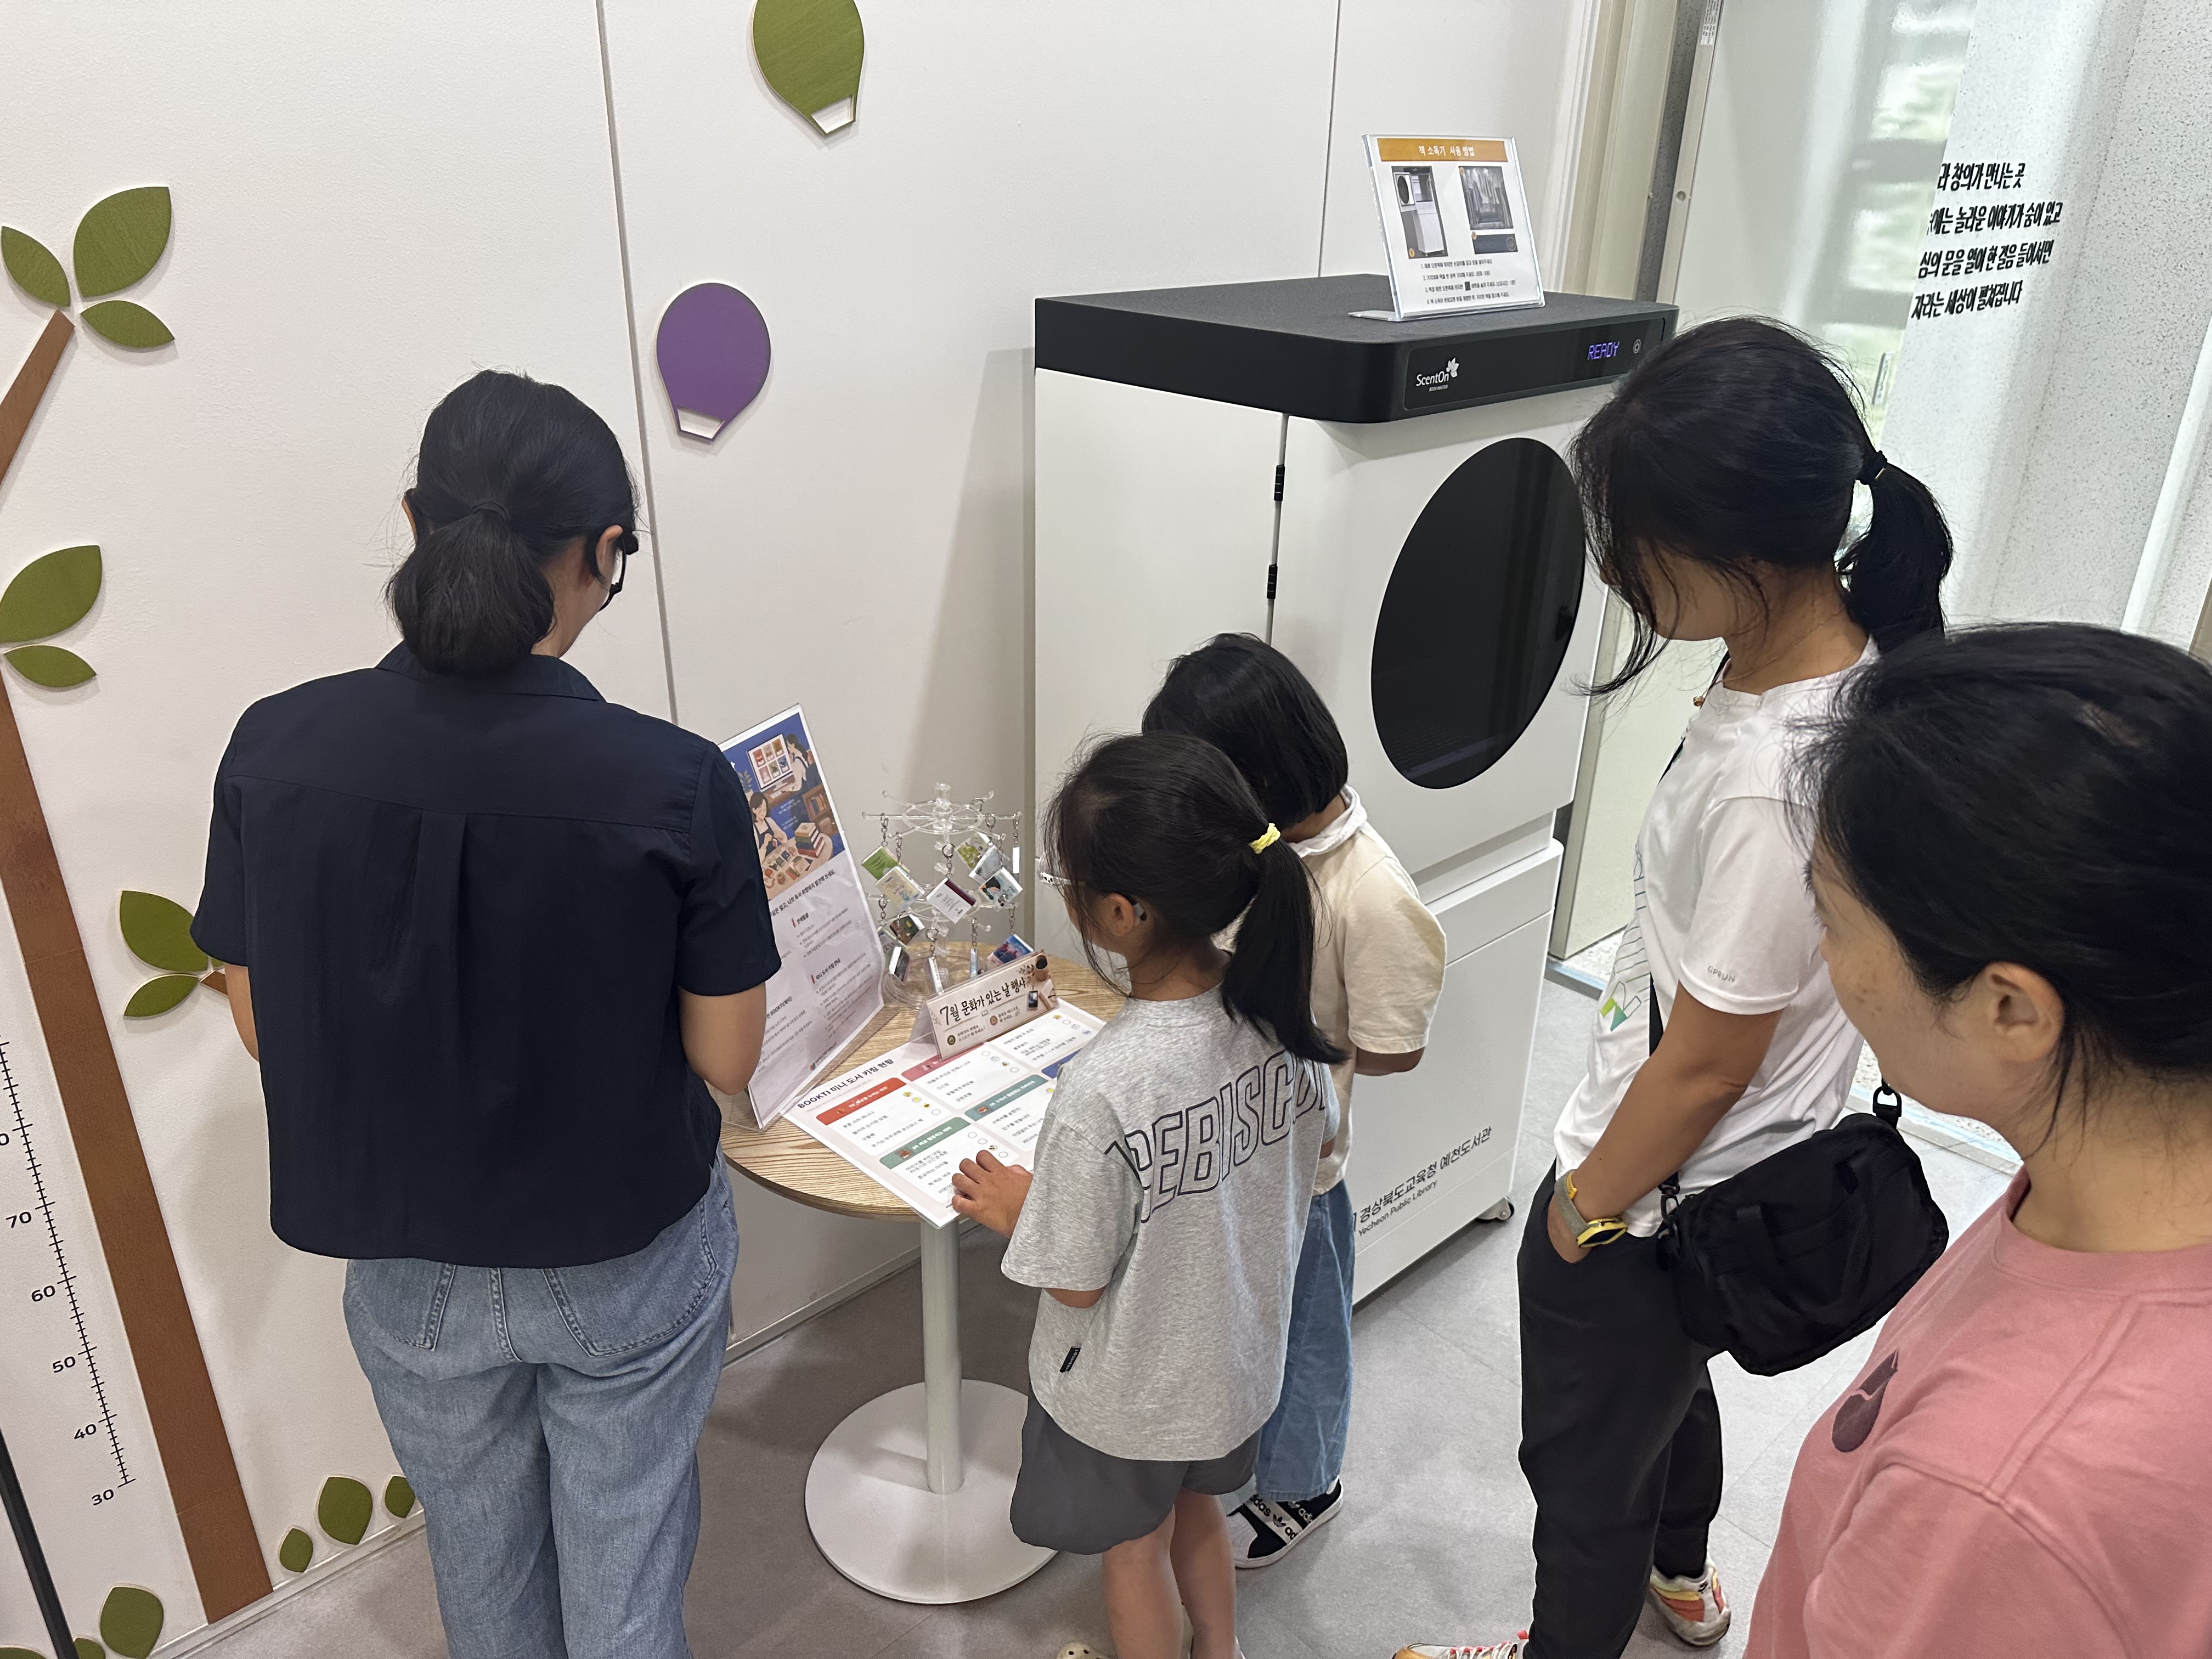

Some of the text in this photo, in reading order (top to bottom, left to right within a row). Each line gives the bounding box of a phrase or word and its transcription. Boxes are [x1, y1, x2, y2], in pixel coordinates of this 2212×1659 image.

[1419, 146, 1475, 156] 책 소독기 사용 방법
[1951, 163, 1984, 191] 창의가
[1984, 162, 2013, 190] 만나는
[2013, 163, 2025, 188] 곳
[1927, 201, 2063, 235] 에는 놀라운 이야기가 숨어 있고
[1942, 249, 1965, 275] 문을
[1965, 247, 1987, 274] 열어
[1986, 245, 1997, 271] 한
[1997, 244, 2017, 270] 걸음
[2016, 239, 2054, 268] 들어서면
[1911, 280, 2023, 319] 자라는 세상이 펼쳐집니다
[1588, 341, 1620, 360] READY
[1416, 371, 1449, 386] ScentOn
[940, 977, 1025, 1025] 7월 문화가 있는 날 행사
[798, 1090, 831, 1108] BOOKTI
[830, 1082, 848, 1091] 미니
[847, 1074, 864, 1084] 도서
[862, 1066, 879, 1075] 키링
[878, 1059, 894, 1068] 현황
[1360, 1126, 1492, 1223] 경상북도교육청 예천도서관
[1390, 1197, 1411, 1215] Public
[1413, 1180, 1437, 1200] Library
[5, 1211, 32, 1228] 70
[31, 1285, 56, 1302] 60
[52, 1356, 77, 1373] 50
[74, 1424, 97, 1441] 40
[92, 1488, 115, 1506] 30
